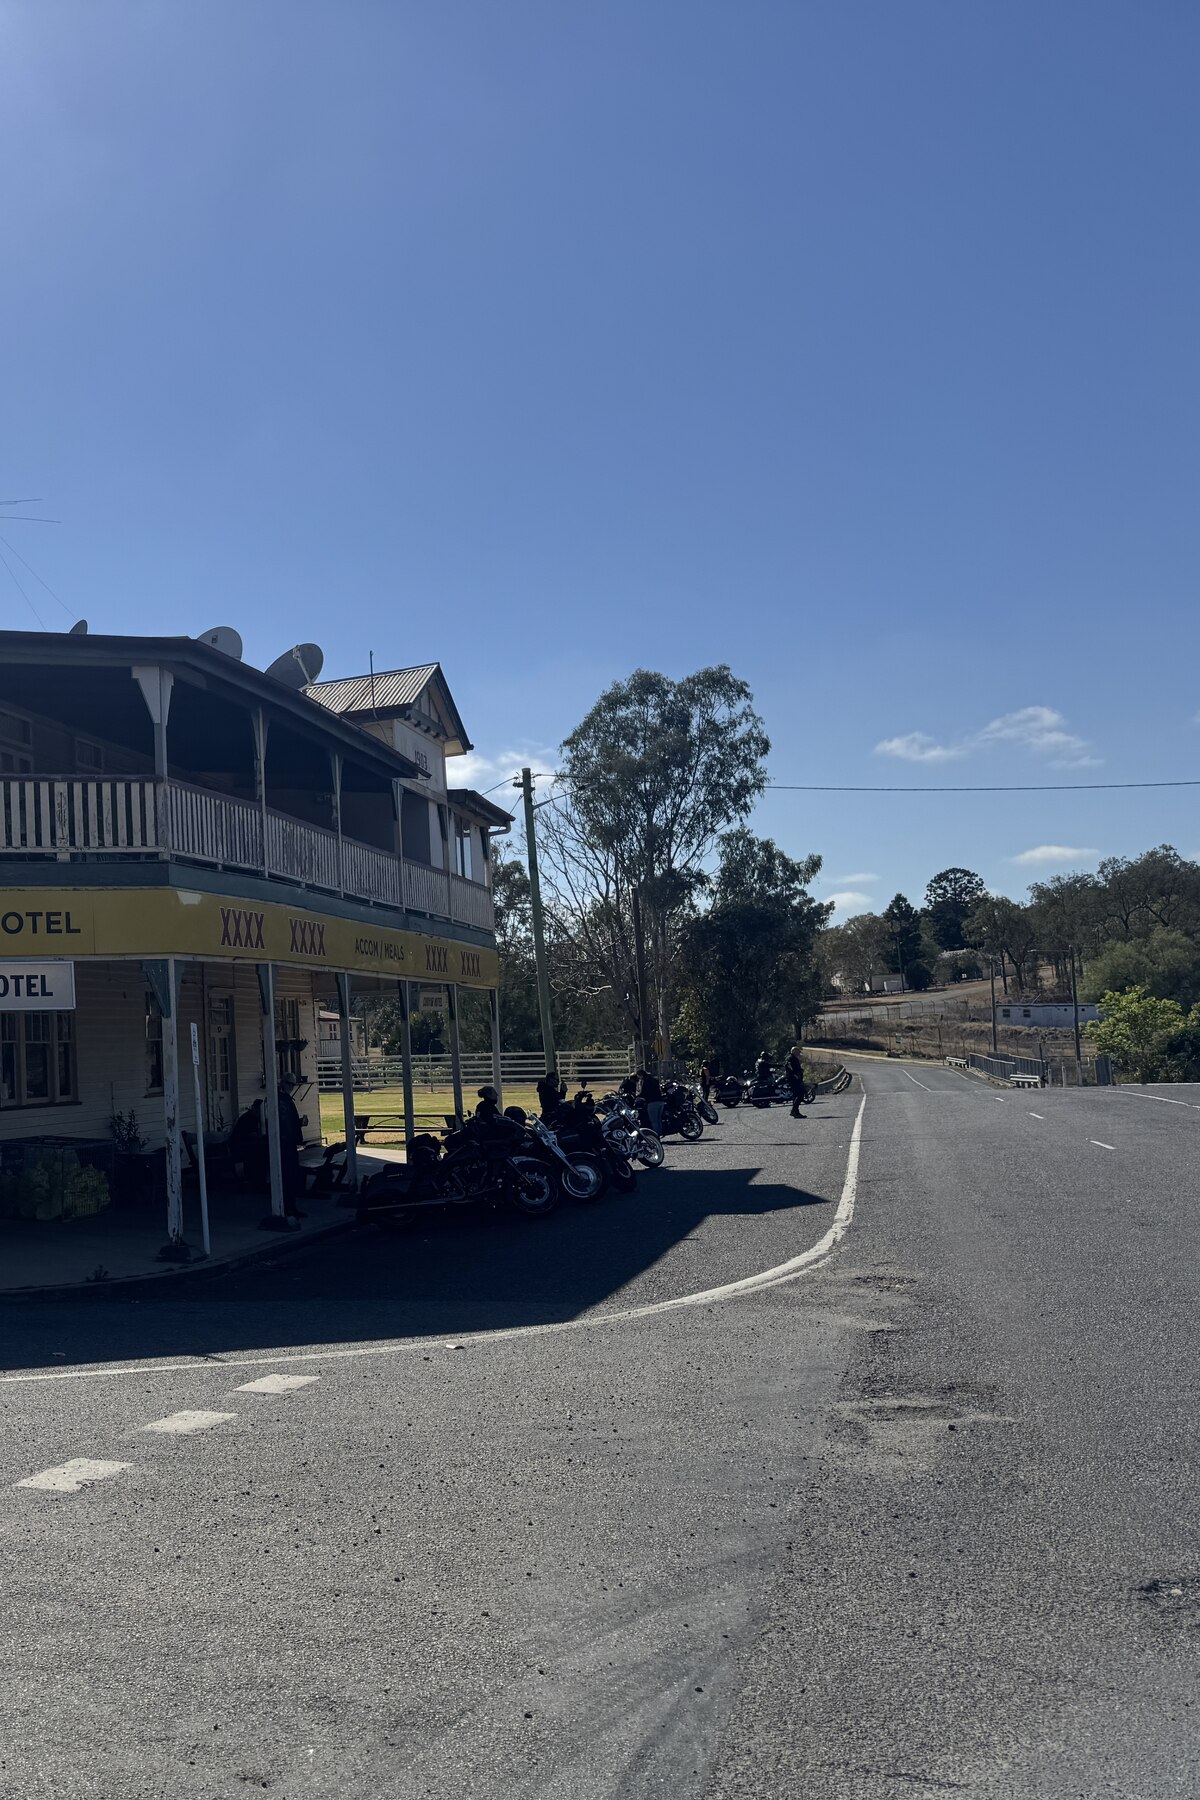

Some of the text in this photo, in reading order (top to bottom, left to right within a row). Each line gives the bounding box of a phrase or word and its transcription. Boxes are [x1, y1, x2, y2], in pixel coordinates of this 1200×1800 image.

[219, 907, 265, 949] XXXX
[288, 917, 327, 957] XXXX
[355, 937, 379, 957] ACCOM
[384, 943, 405, 961] MEALS
[425, 944, 448, 973] XXXX
[460, 951, 481, 977] XXXX
